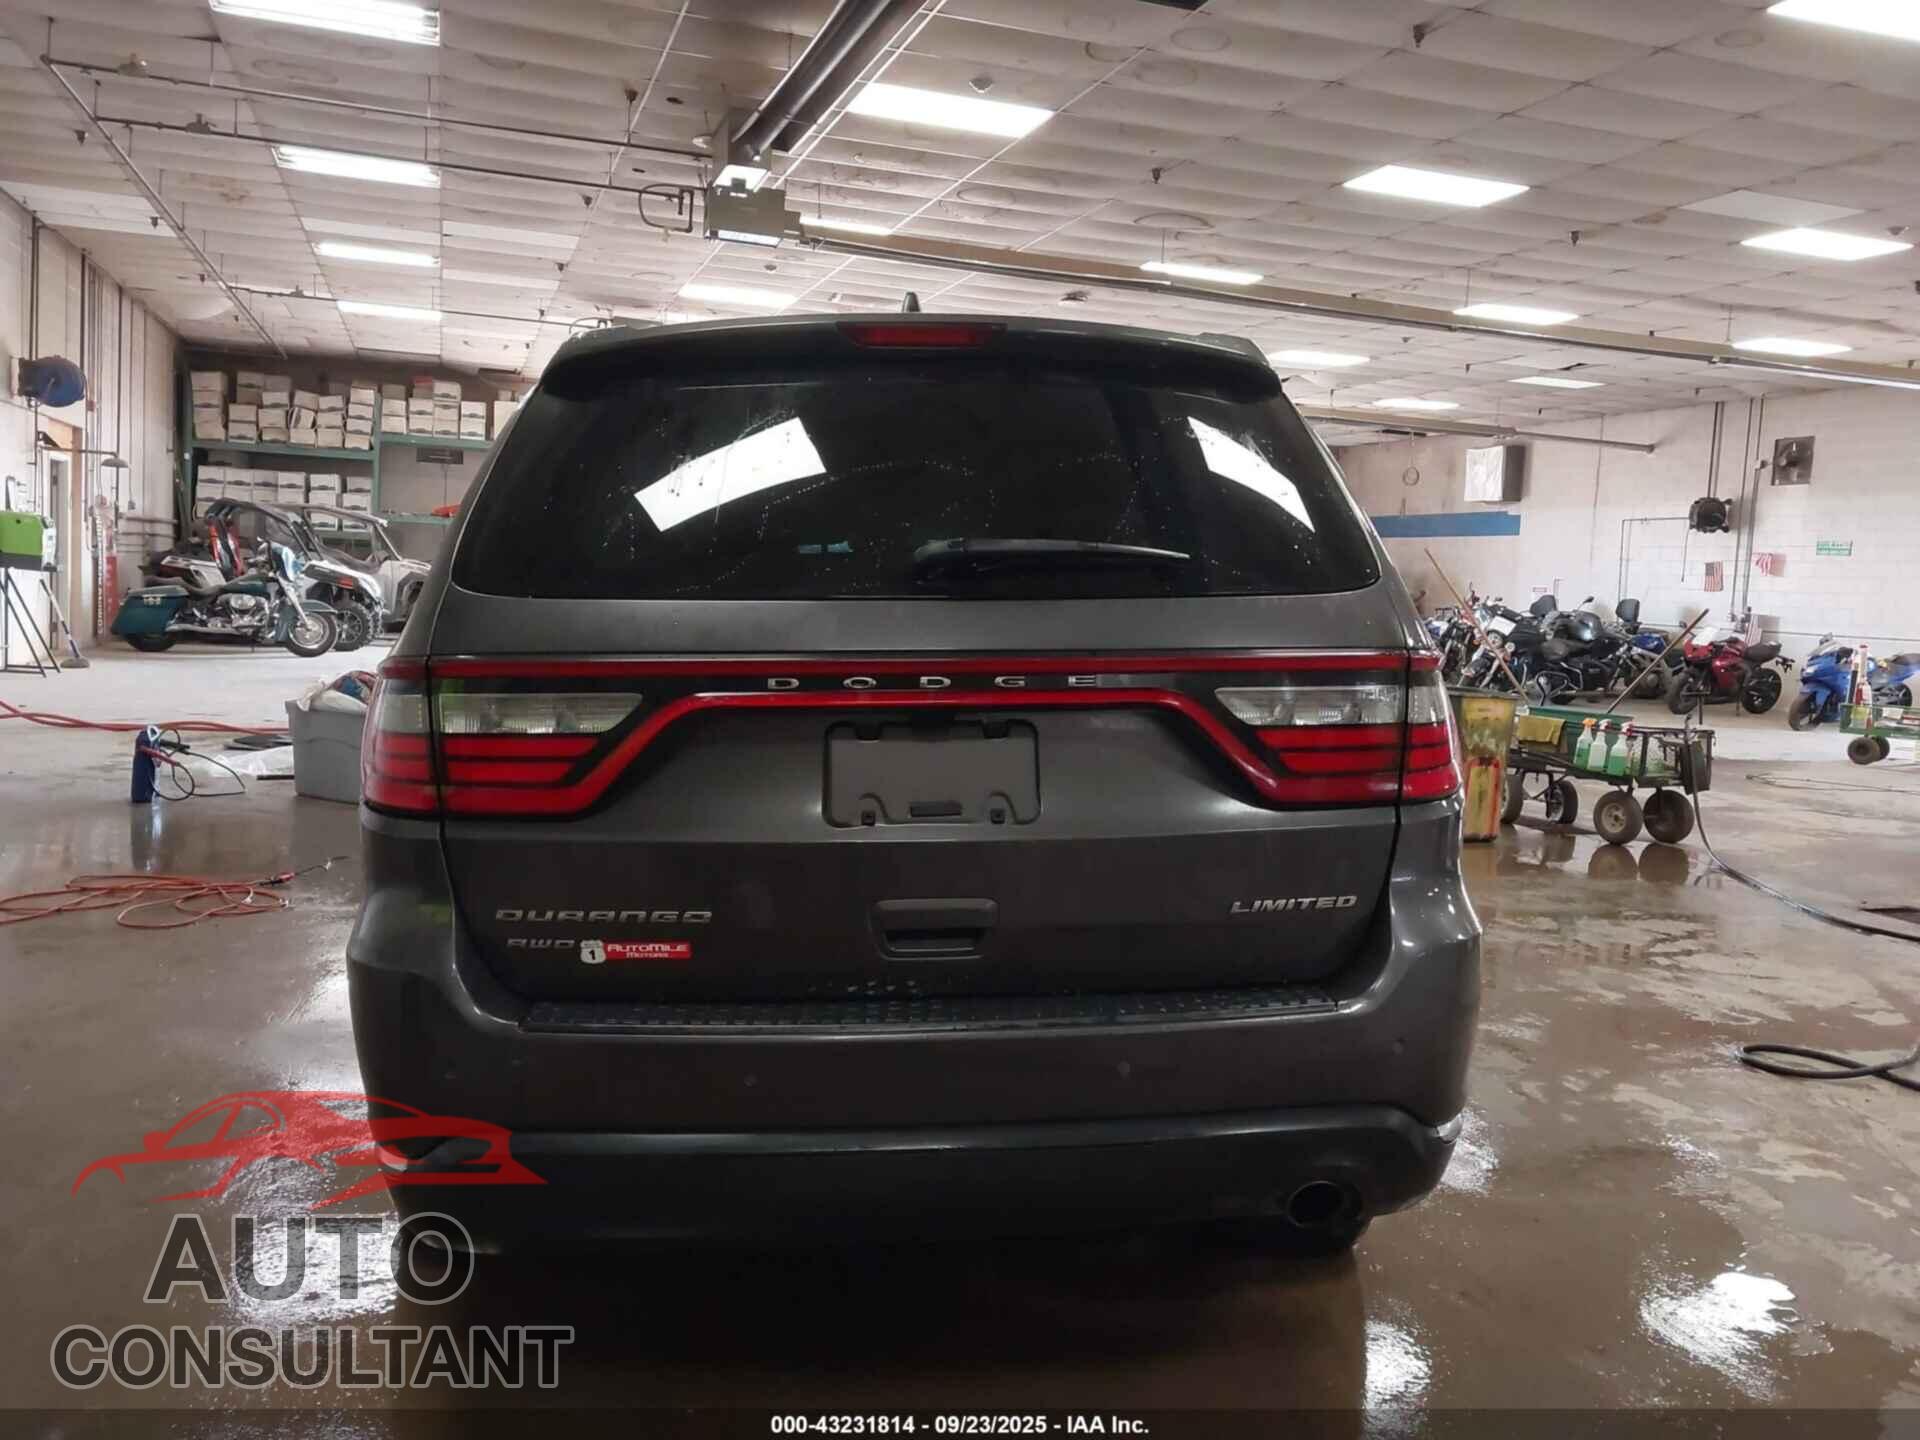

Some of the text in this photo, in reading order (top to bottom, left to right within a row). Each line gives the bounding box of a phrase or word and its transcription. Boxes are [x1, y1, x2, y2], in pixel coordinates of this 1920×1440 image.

[767, 675, 1097, 690] DODGE
[1230, 895, 1358, 914] LIMITED
[495, 908, 713, 924] DURANGO
[506, 937, 576, 950] AWD
[588, 948, 597, 961] 1
